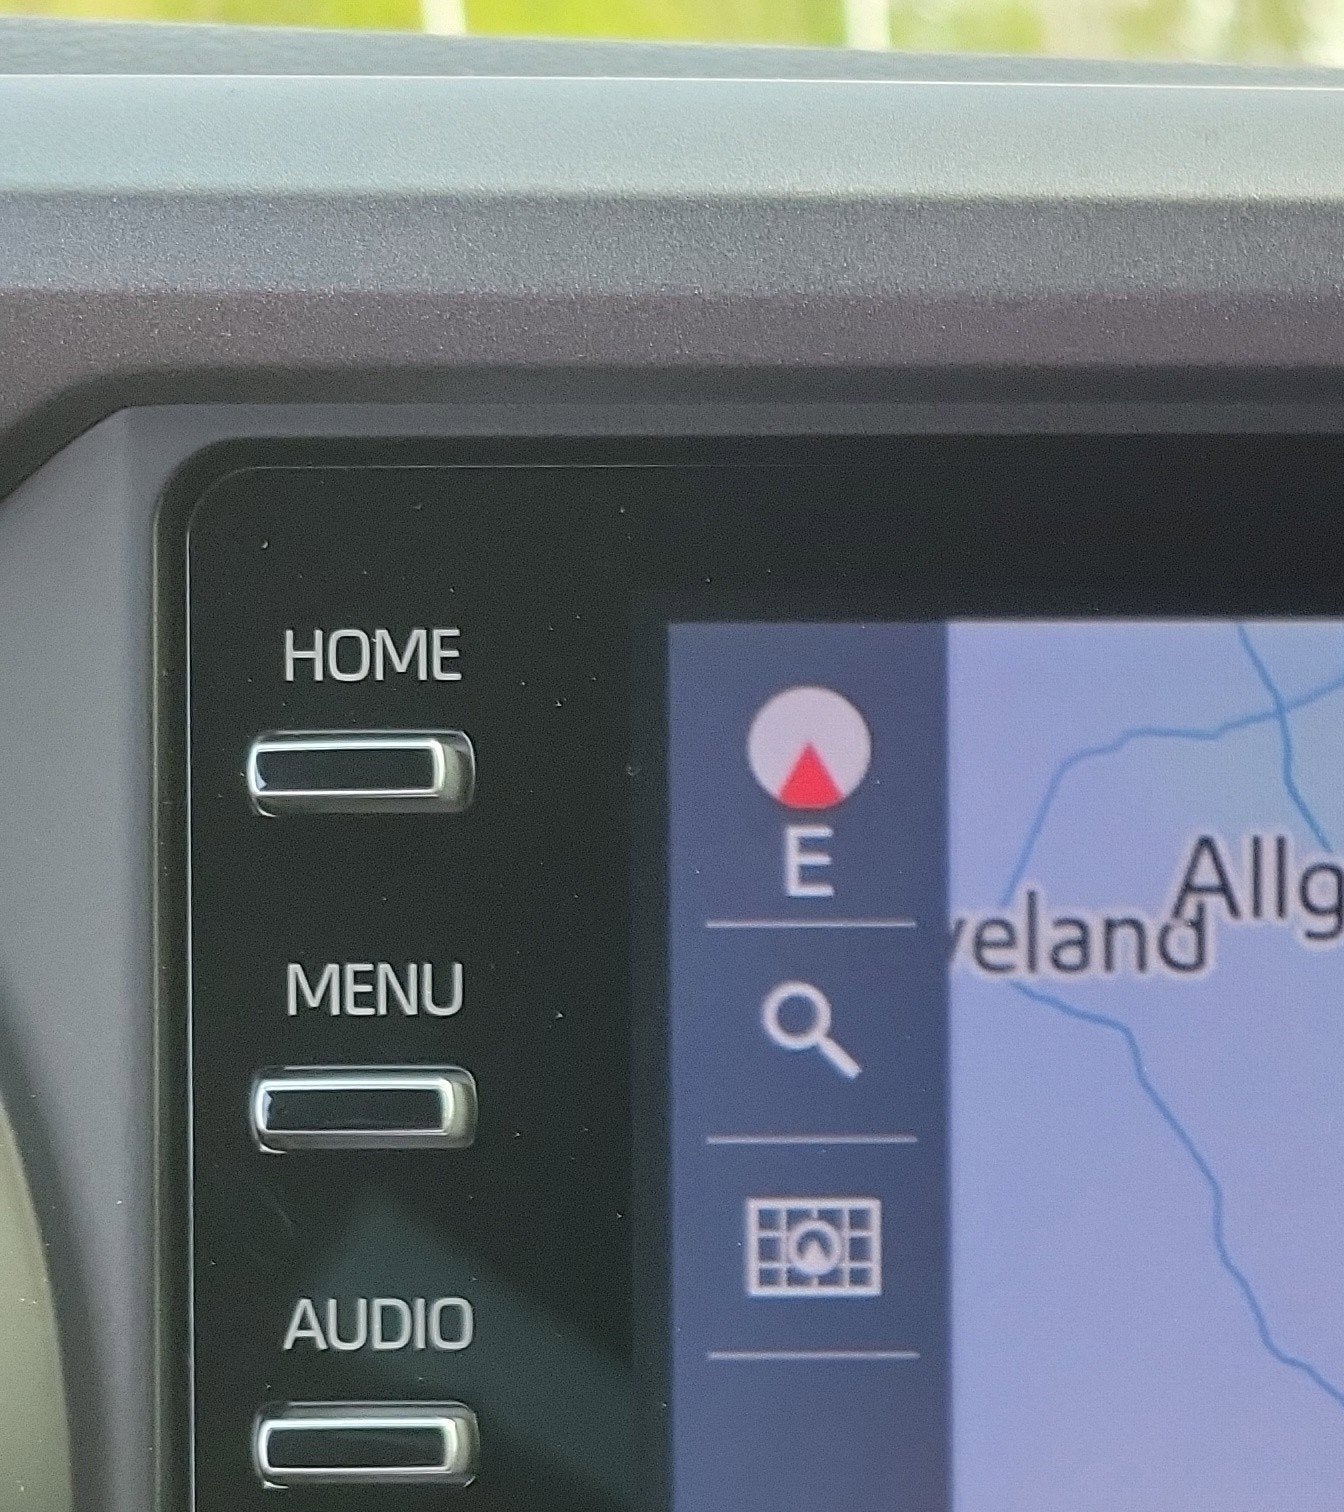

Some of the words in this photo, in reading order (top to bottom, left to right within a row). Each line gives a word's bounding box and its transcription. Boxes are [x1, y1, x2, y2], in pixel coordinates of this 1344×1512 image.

[284, 628, 463, 682] HOME
[784, 826, 835, 897] E
[286, 962, 466, 1018] MENU
[282, 1296, 476, 1352] AUDIO
